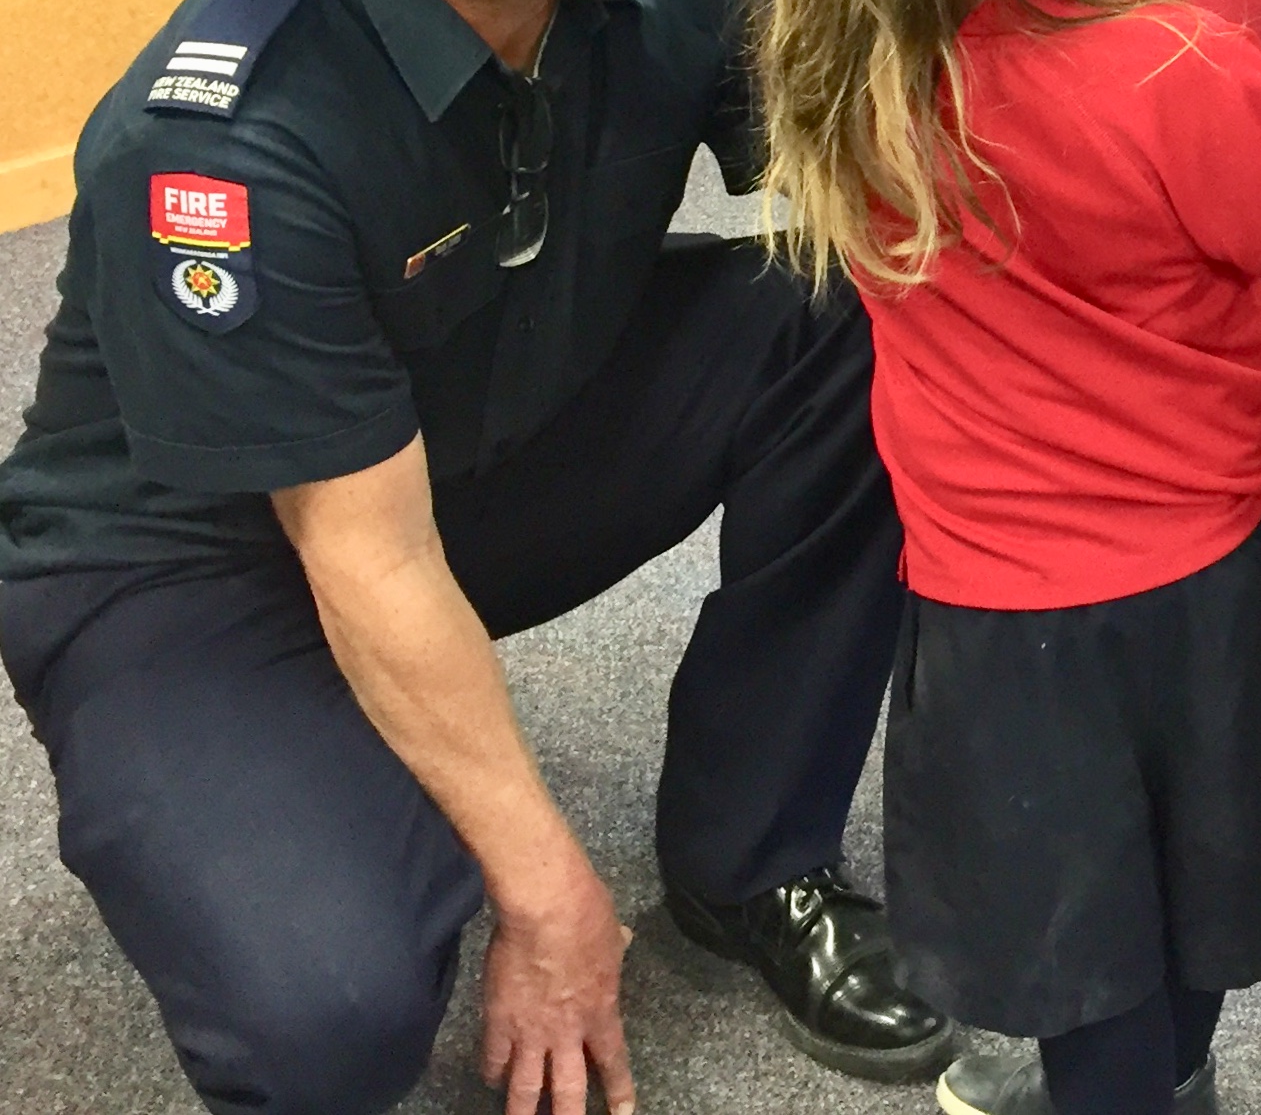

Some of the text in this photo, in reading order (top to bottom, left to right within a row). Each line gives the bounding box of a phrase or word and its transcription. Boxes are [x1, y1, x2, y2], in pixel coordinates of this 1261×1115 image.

[151, 75, 240, 97] NEW ZEALAND
[171, 88, 232, 109] SERVICE
[165, 187, 227, 217] FIRE
[165, 212, 227, 228] EMERGENCY
